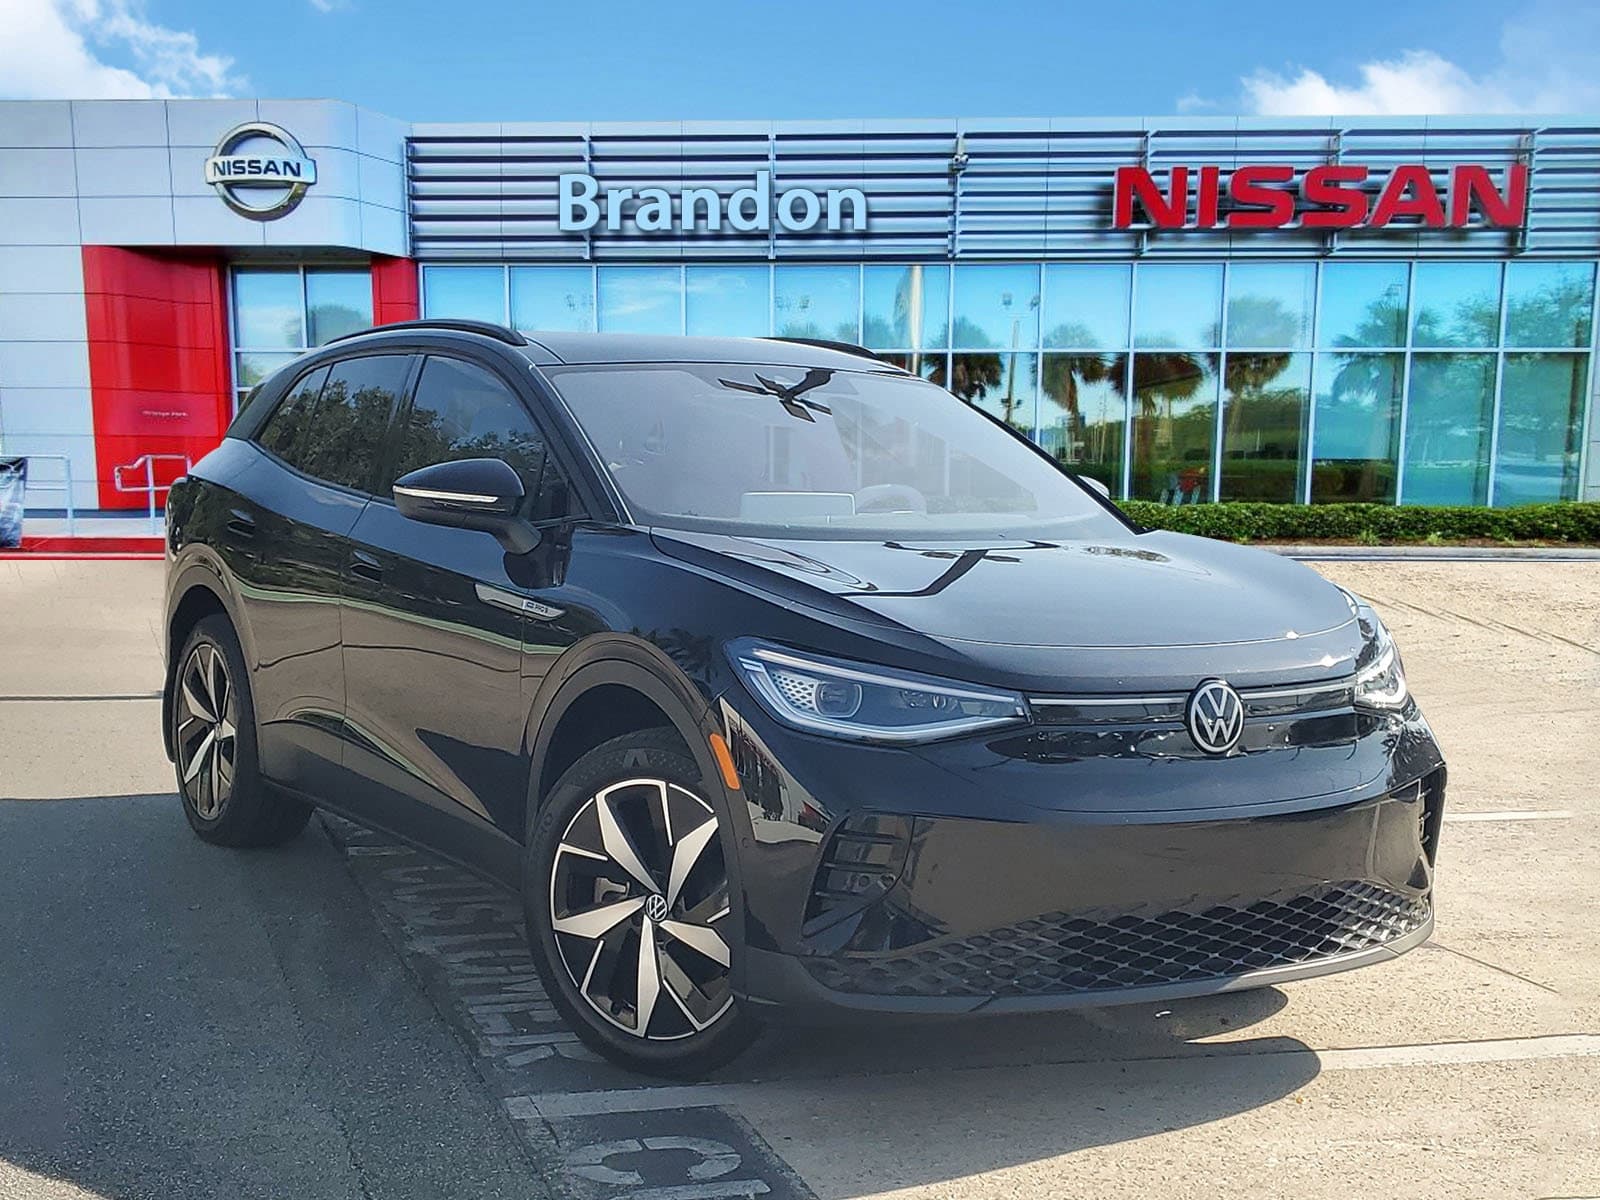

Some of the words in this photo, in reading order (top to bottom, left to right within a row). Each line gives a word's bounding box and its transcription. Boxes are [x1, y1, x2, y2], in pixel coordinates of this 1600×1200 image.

[213, 159, 301, 177] NISSAN
[1113, 165, 1528, 229] NISSAN
[559, 170, 867, 231] Brandon
[1192, 683, 1242, 750] VW
